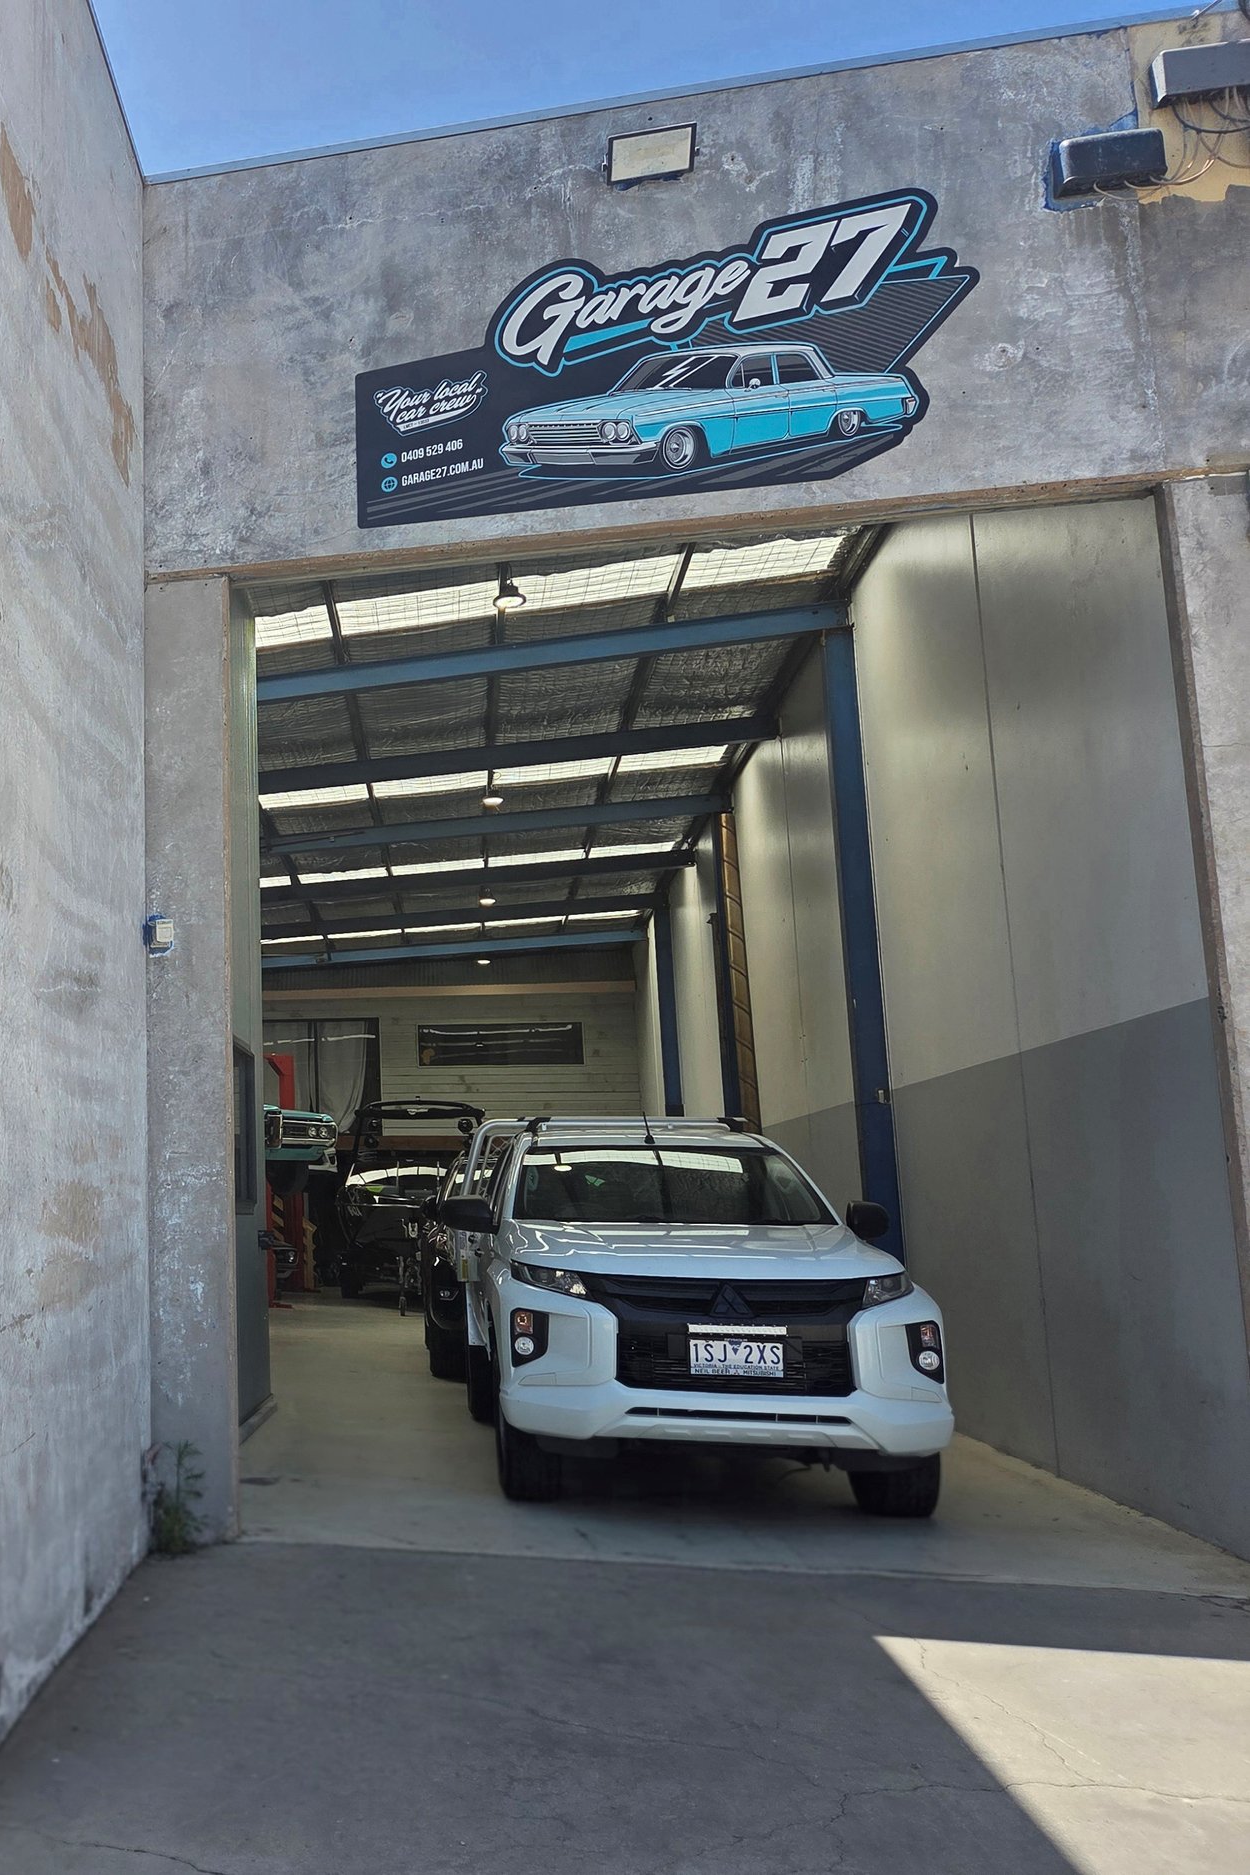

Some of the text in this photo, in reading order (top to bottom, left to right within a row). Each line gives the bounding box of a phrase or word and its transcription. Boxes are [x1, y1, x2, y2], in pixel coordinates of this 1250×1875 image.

[503, 203, 912, 366] Garage 27
[434, 373, 482, 400] local
[396, 405, 427, 423] car
[401, 438, 463, 463] 0409 529 406
[401, 458, 484, 486] GARAGE27.COM.AU
[743, 1344, 781, 1365] 2XS
